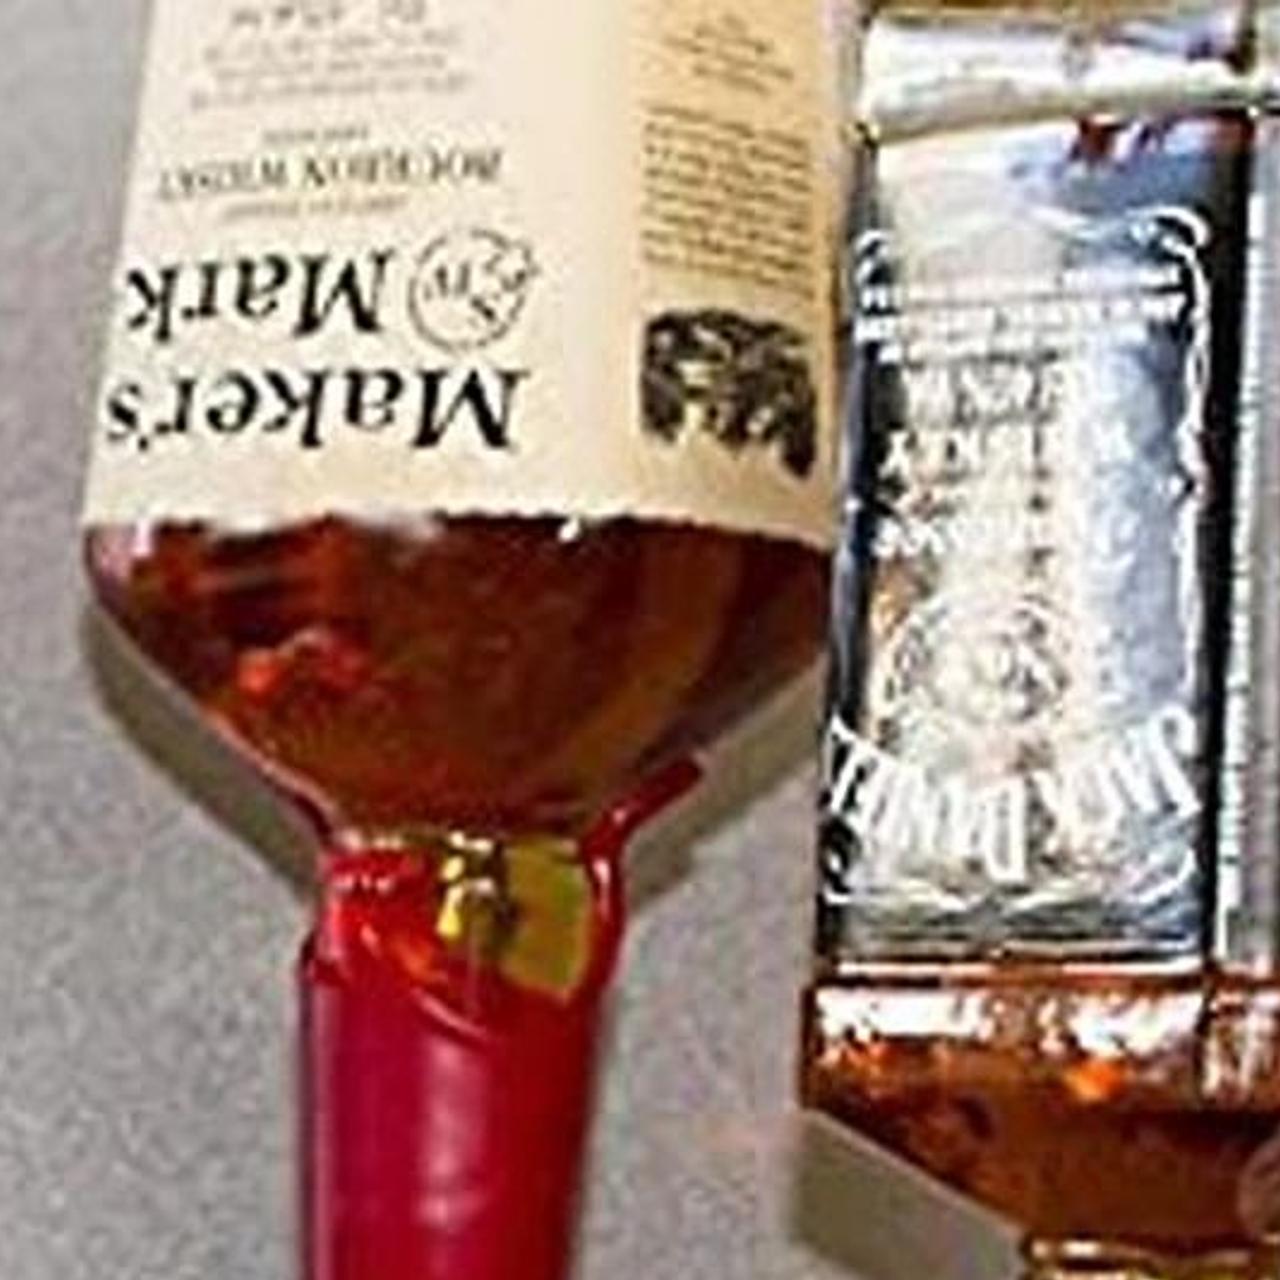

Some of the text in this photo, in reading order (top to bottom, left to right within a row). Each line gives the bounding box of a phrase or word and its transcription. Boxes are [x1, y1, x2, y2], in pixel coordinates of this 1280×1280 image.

[126, 249, 394, 344] Mark
[104, 366, 528, 457] Maker's
[1031, 708, 1200, 854] JACK
